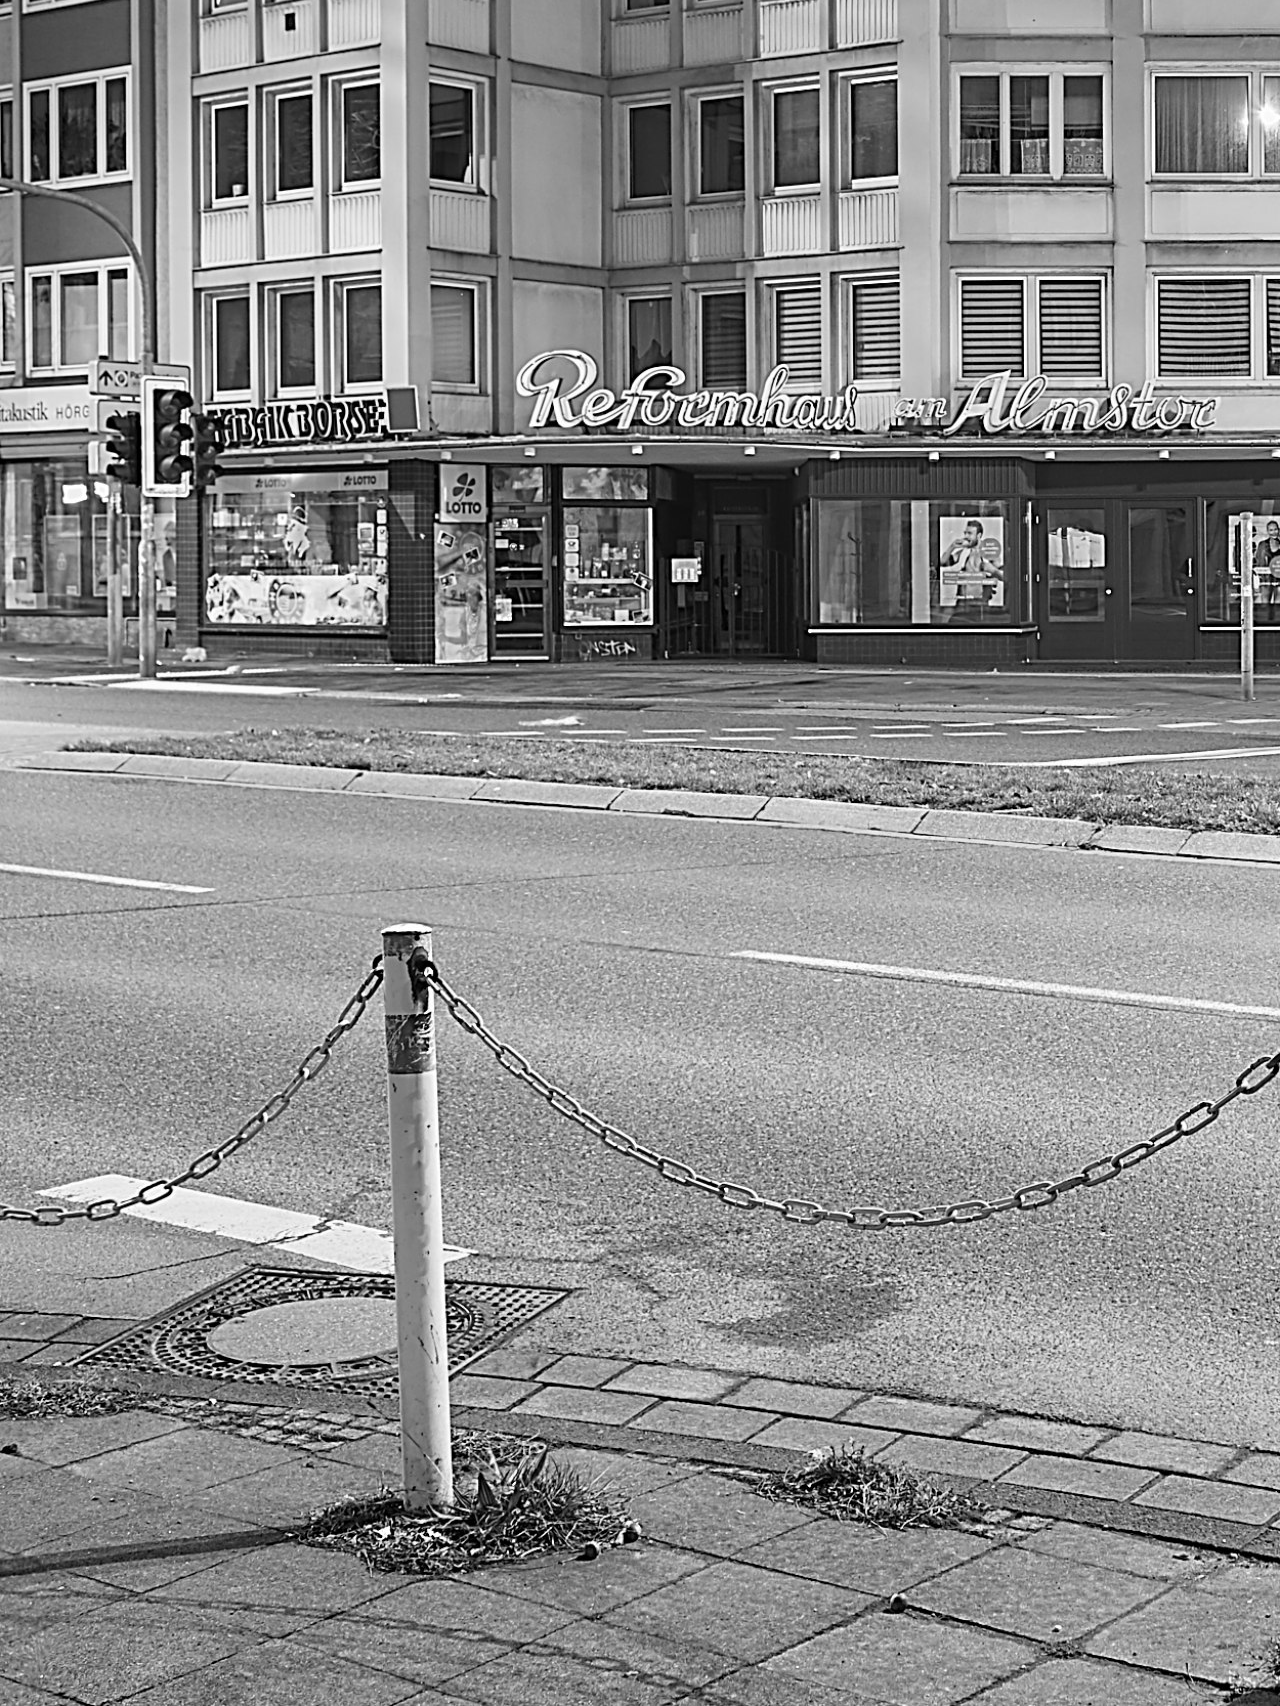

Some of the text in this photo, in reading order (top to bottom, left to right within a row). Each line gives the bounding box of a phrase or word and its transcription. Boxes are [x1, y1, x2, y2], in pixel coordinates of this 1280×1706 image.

[516, 349, 858, 430] Reformhaus
[893, 397, 947, 419] am
[264, 478, 287, 488] LOTTO
[353, 475, 377, 486] LOTTO
[446, 501, 482, 514] LOTTO
